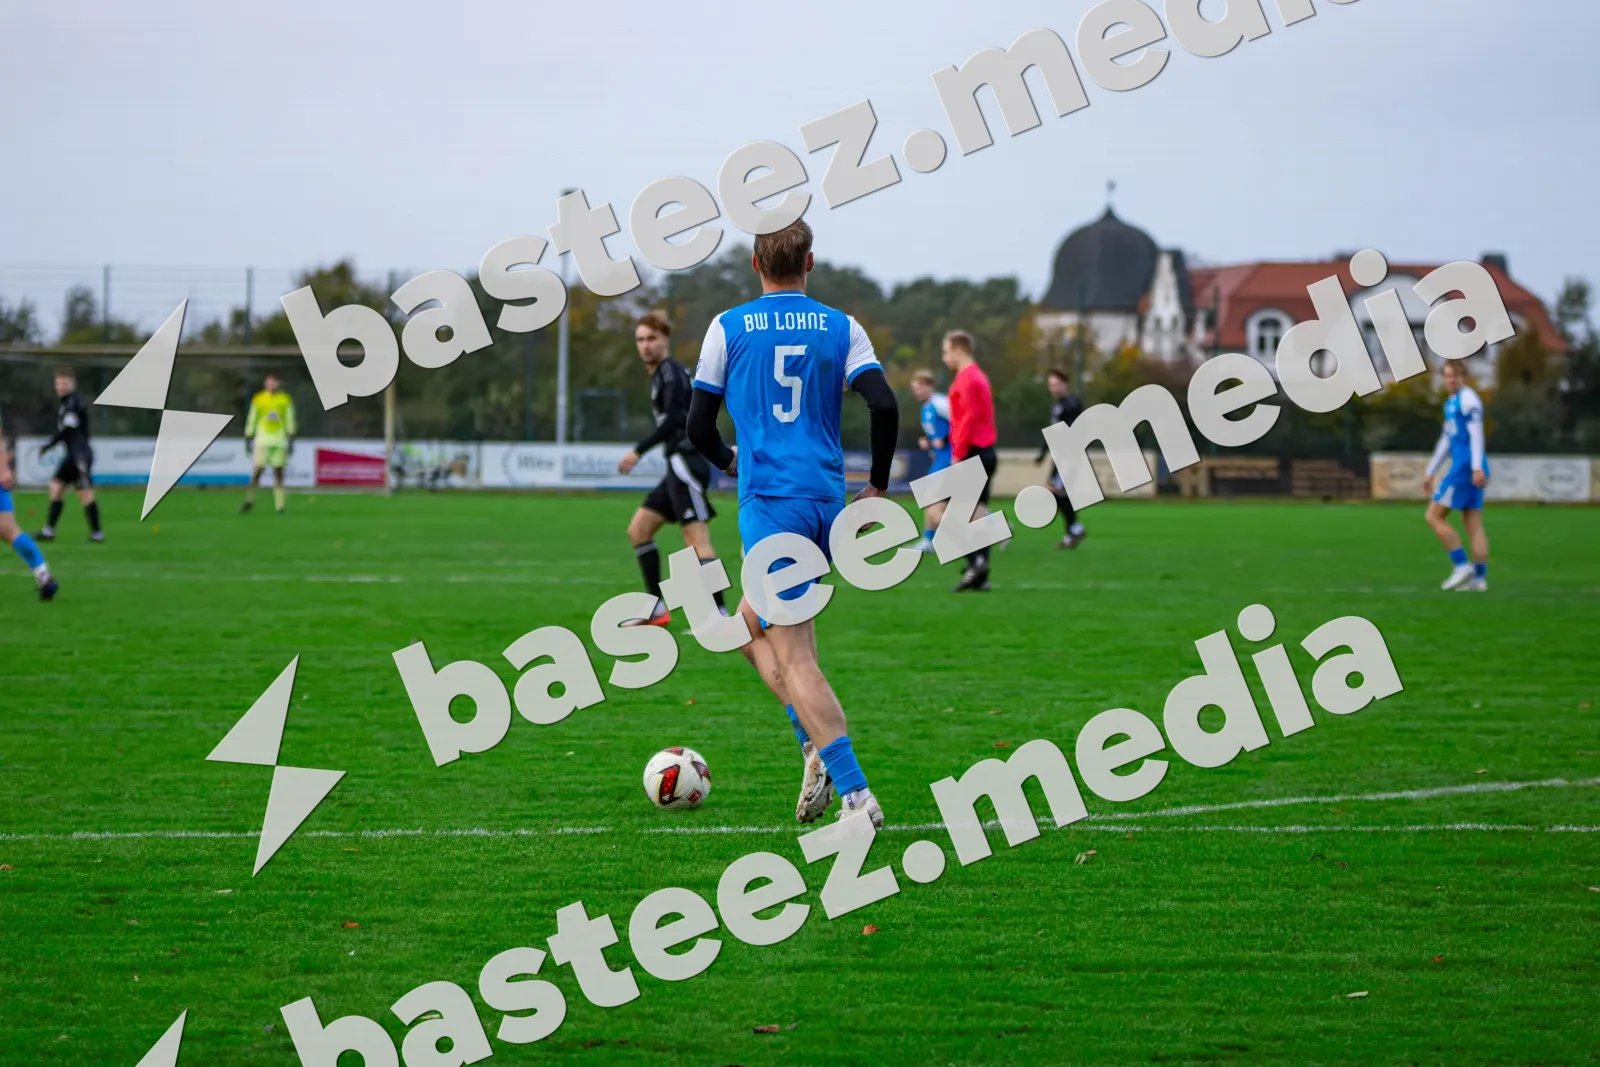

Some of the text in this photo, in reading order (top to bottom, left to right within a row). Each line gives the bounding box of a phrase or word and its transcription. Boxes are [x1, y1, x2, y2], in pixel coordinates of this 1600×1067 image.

[743, 312, 829, 333] BW LOHNE
[772, 344, 808, 424] 5
